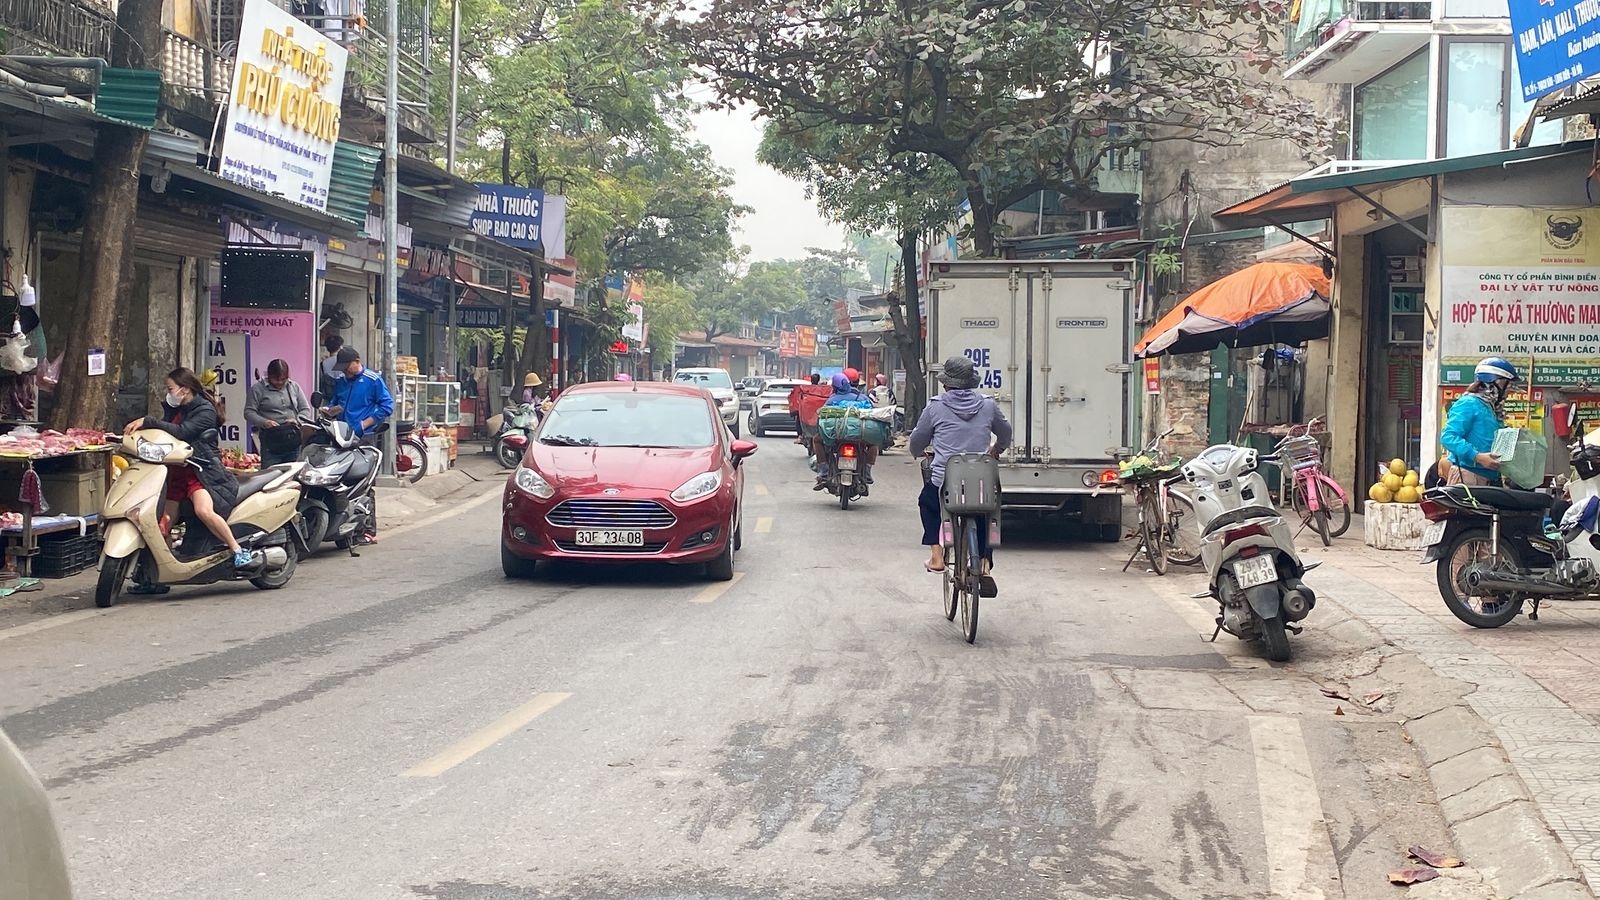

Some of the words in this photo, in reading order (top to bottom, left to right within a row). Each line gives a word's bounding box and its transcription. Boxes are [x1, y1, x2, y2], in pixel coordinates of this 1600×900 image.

[1519, 27, 1540, 56] ĐẠM,
[1537, 17, 1557, 45] LÂN,
[1554, 8, 1577, 37] KALI,
[261, 26, 293, 66] NHÀ
[290, 40, 333, 84] THUỐC
[1567, 38, 1583, 58] Bán
[237, 62, 282, 116] PHÚ
[280, 79, 342, 144] CƯỜNG
[474, 191, 499, 214] NHÀ
[502, 191, 539, 218] THUỐC
[471, 217, 493, 237] SHOP
[494, 222, 510, 238] BAO
[511, 224, 526, 240] CAO
[528, 223, 539, 241] SU
[1479, 272, 1502, 281] CÔNG
[1516, 271, 1528, 281] CỔ
[1530, 271, 1552, 281] PHẦN
[1554, 272, 1575, 281] BÌNH
[1480, 284, 1500, 293] ĐẠI
[1504, 283, 1518, 292] LÝ
[1522, 283, 1544, 293] VẬT
[1547, 283, 1565, 292] TƯ
[1567, 283, 1599, 292] NÔNG
[266, 315, 294, 327] NHẤT
[1452, 300, 1477, 328] HỢP
[1480, 298, 1503, 324] TÁC
[1507, 299, 1523, 324] XÃ
[1526, 300, 1575, 324] THƯƠNG
[1507, 332, 1548, 342] CHUYÊN
[1551, 334, 1576, 342] KINH
[1508, 344, 1530, 354] LÂN,
[1534, 345, 1557, 353] KALI
[1559, 344, 1574, 354] VÀ
[1575, 344, 1596, 354] CÁC
[1567, 367, 1589, 375] Long
